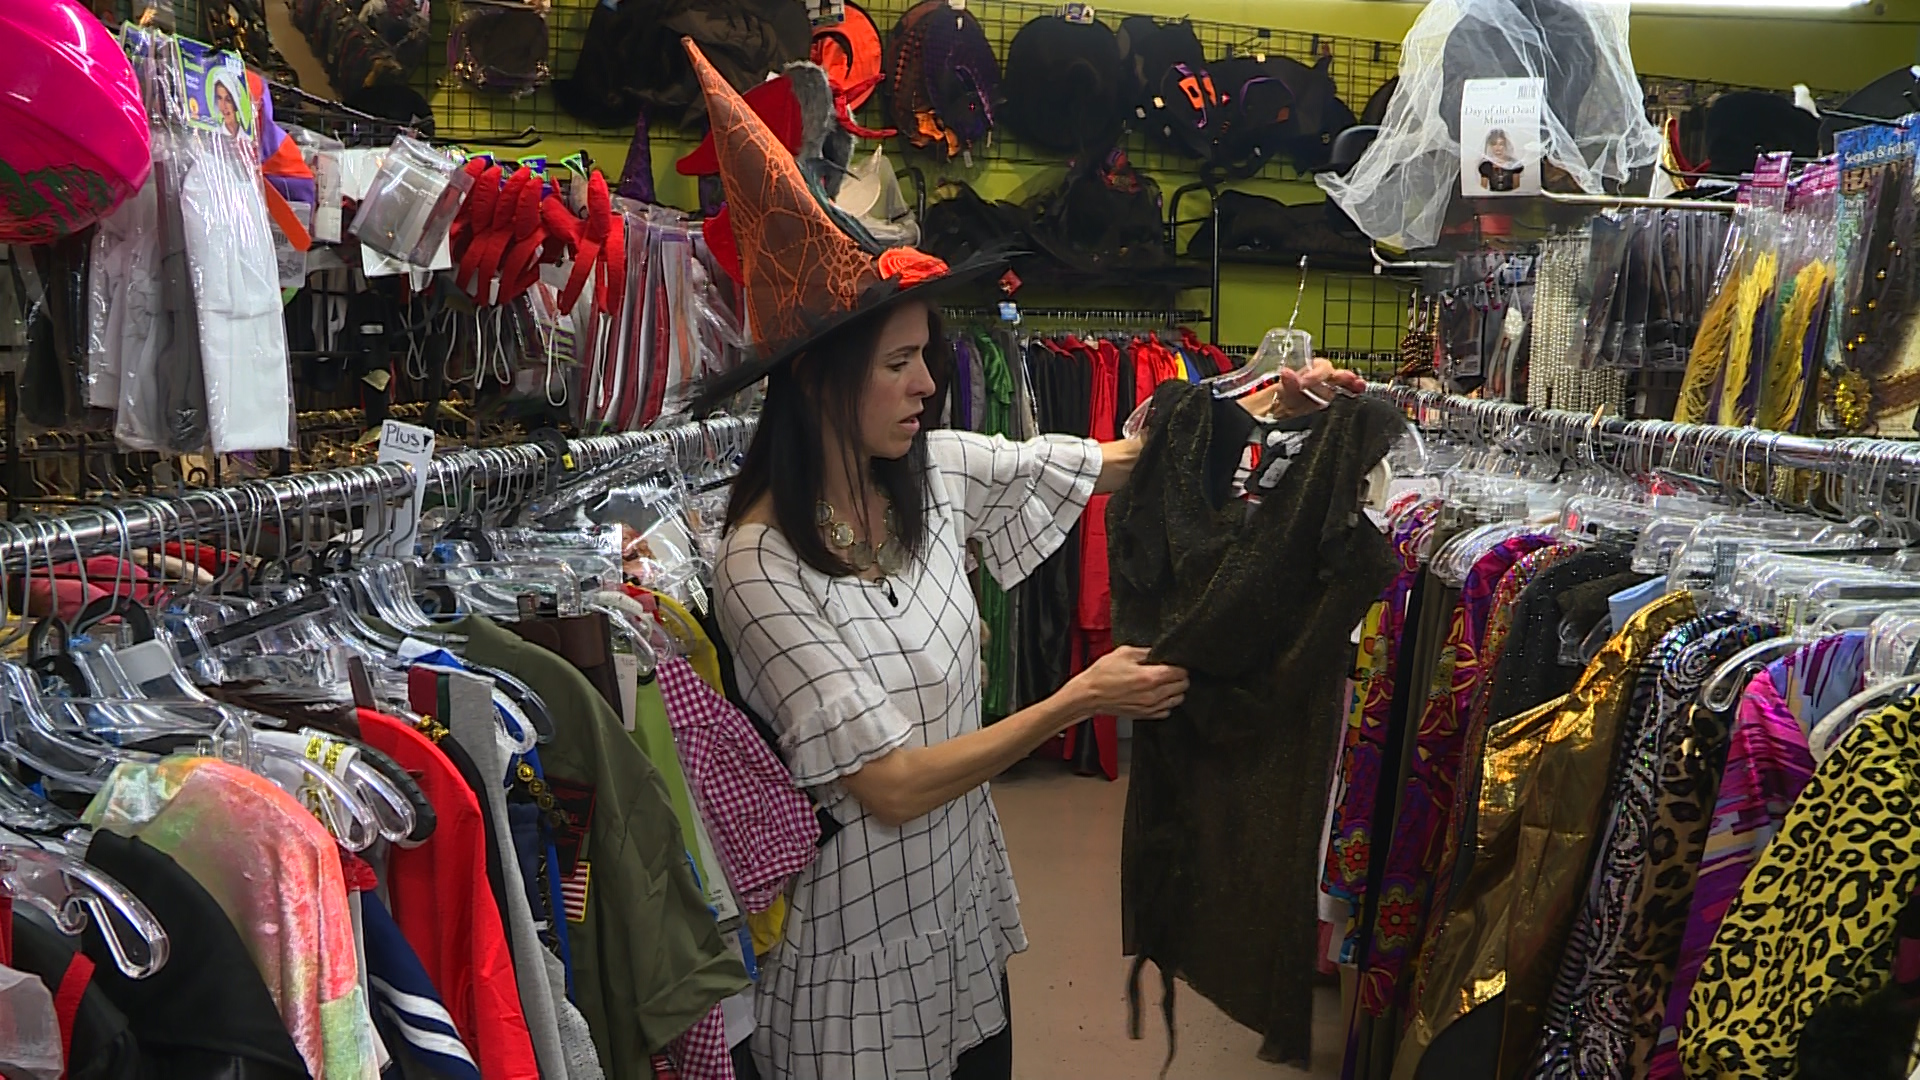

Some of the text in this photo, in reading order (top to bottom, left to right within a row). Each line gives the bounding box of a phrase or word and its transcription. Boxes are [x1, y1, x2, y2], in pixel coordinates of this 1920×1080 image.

[1465, 104, 1535, 117] Day of the Dead
